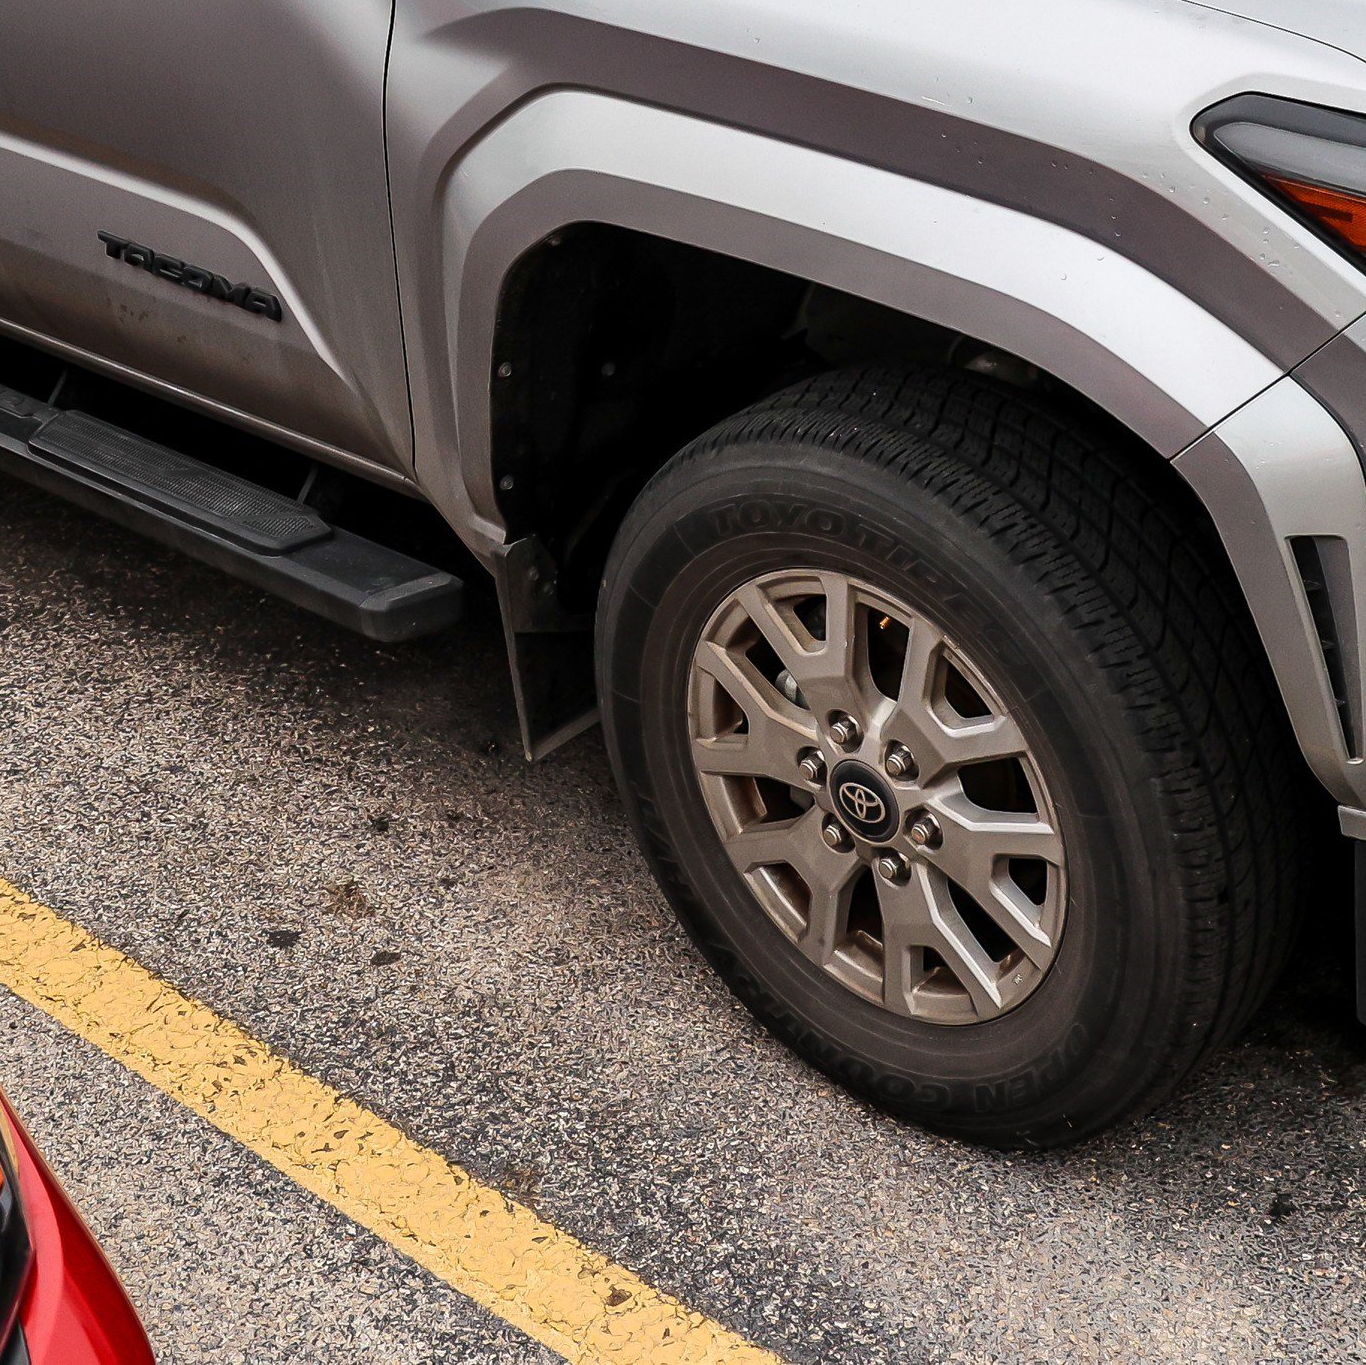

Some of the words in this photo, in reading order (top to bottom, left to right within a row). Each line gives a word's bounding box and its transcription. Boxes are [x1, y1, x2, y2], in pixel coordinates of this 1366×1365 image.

[96, 229, 283, 323] TACOMA
[709, 499, 848, 541] TOYO
[856, 522, 1031, 675] TIRES
[970, 1021, 1091, 1113] OPEN
